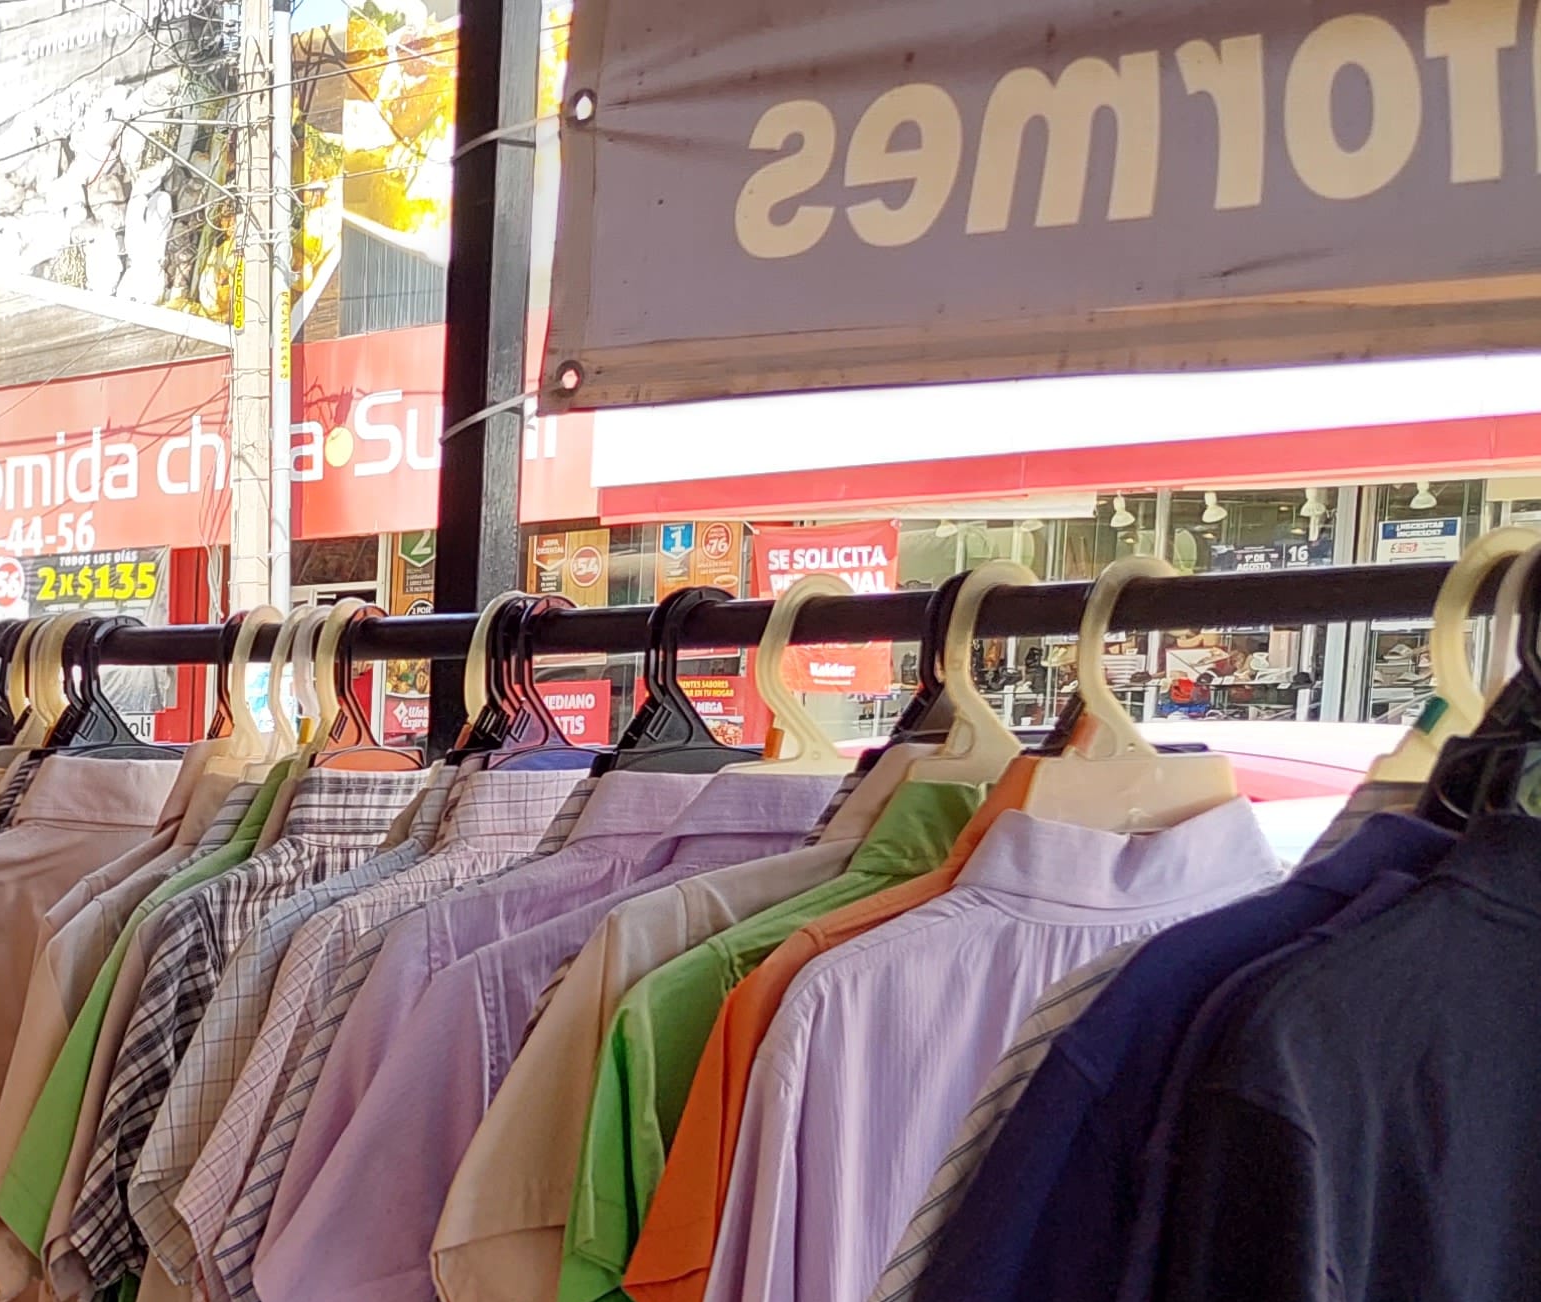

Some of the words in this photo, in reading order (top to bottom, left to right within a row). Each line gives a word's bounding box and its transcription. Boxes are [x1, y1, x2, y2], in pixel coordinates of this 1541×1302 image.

[156, 415, 324, 494] cha
[768, 548, 791, 571] SE
[792, 544, 889, 570] SOLICITA
[769, 570, 890, 599] PENAL
